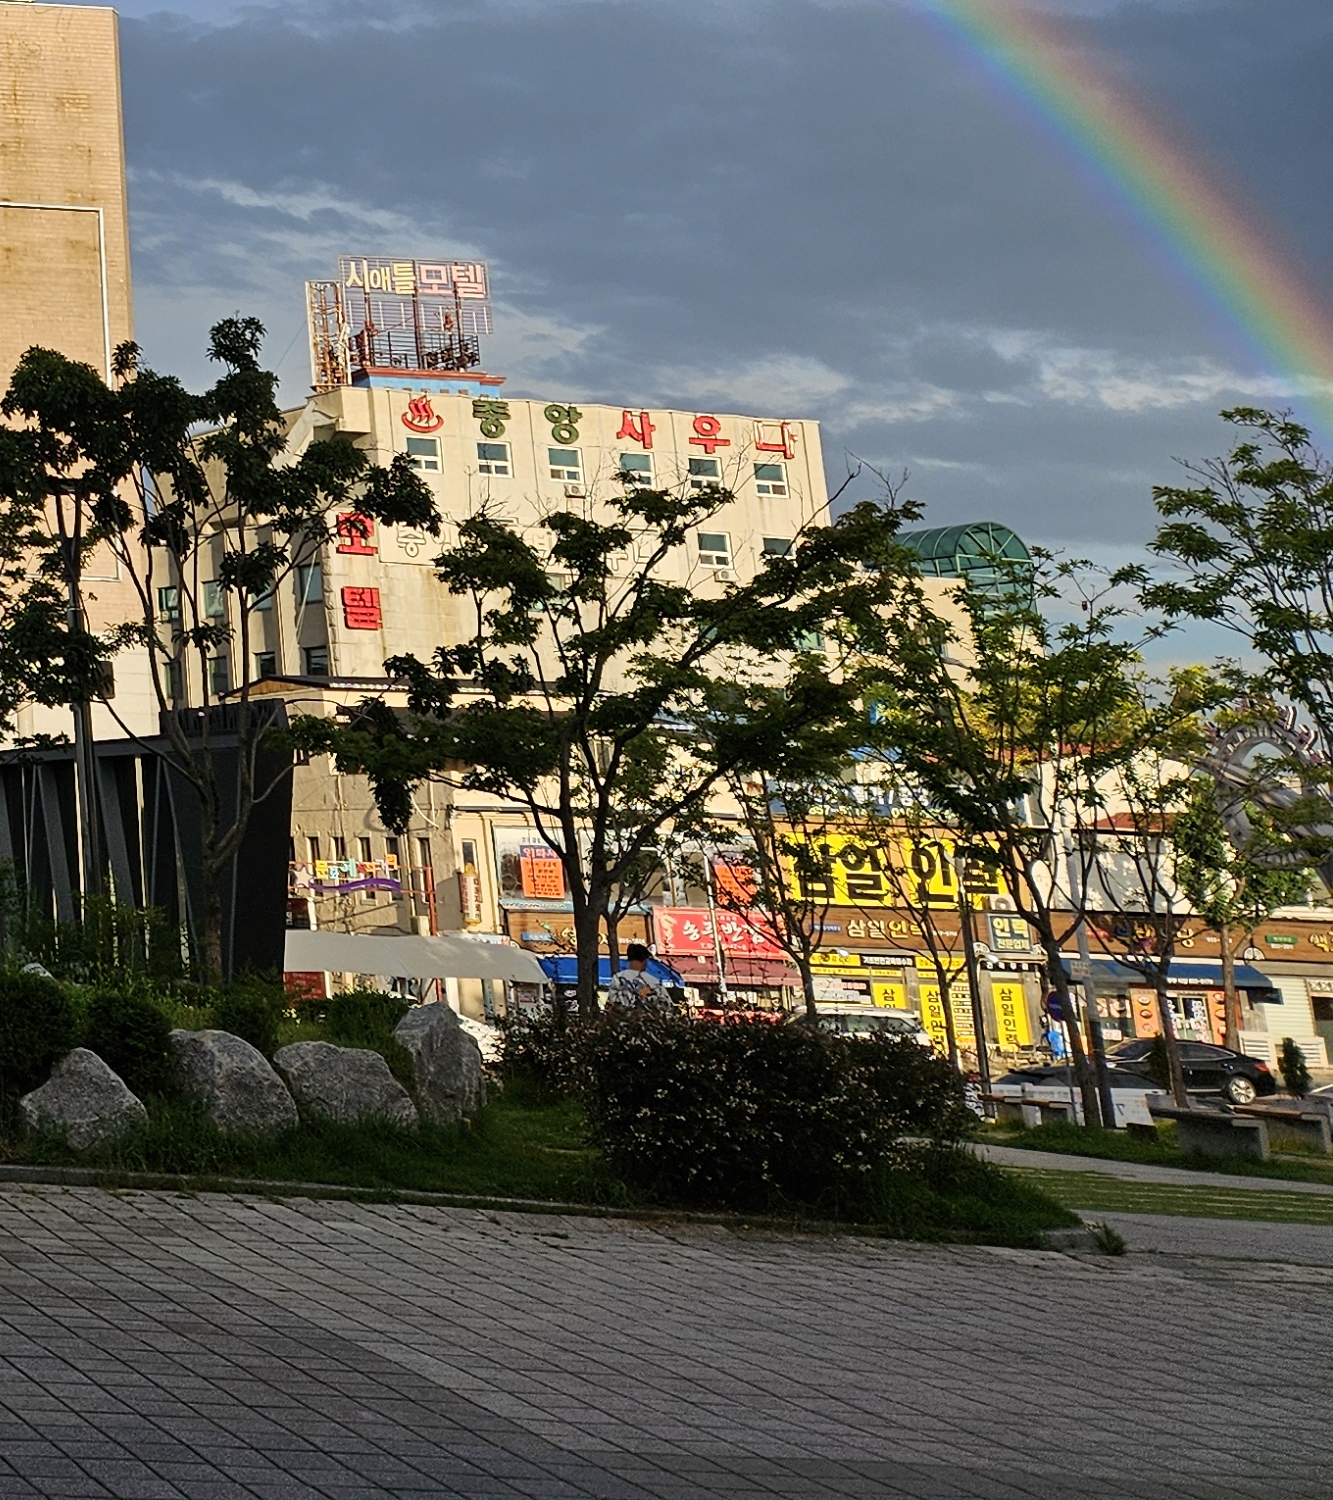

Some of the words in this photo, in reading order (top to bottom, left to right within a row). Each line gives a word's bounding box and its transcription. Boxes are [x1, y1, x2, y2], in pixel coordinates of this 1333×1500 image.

[346, 262, 416, 295] 시애틀
[417, 264, 486, 298] 모텔
[335, 512, 384, 630] 모텔
[846, 919, 928, 940] 삼일인력
[993, 917, 1030, 938] 인력
